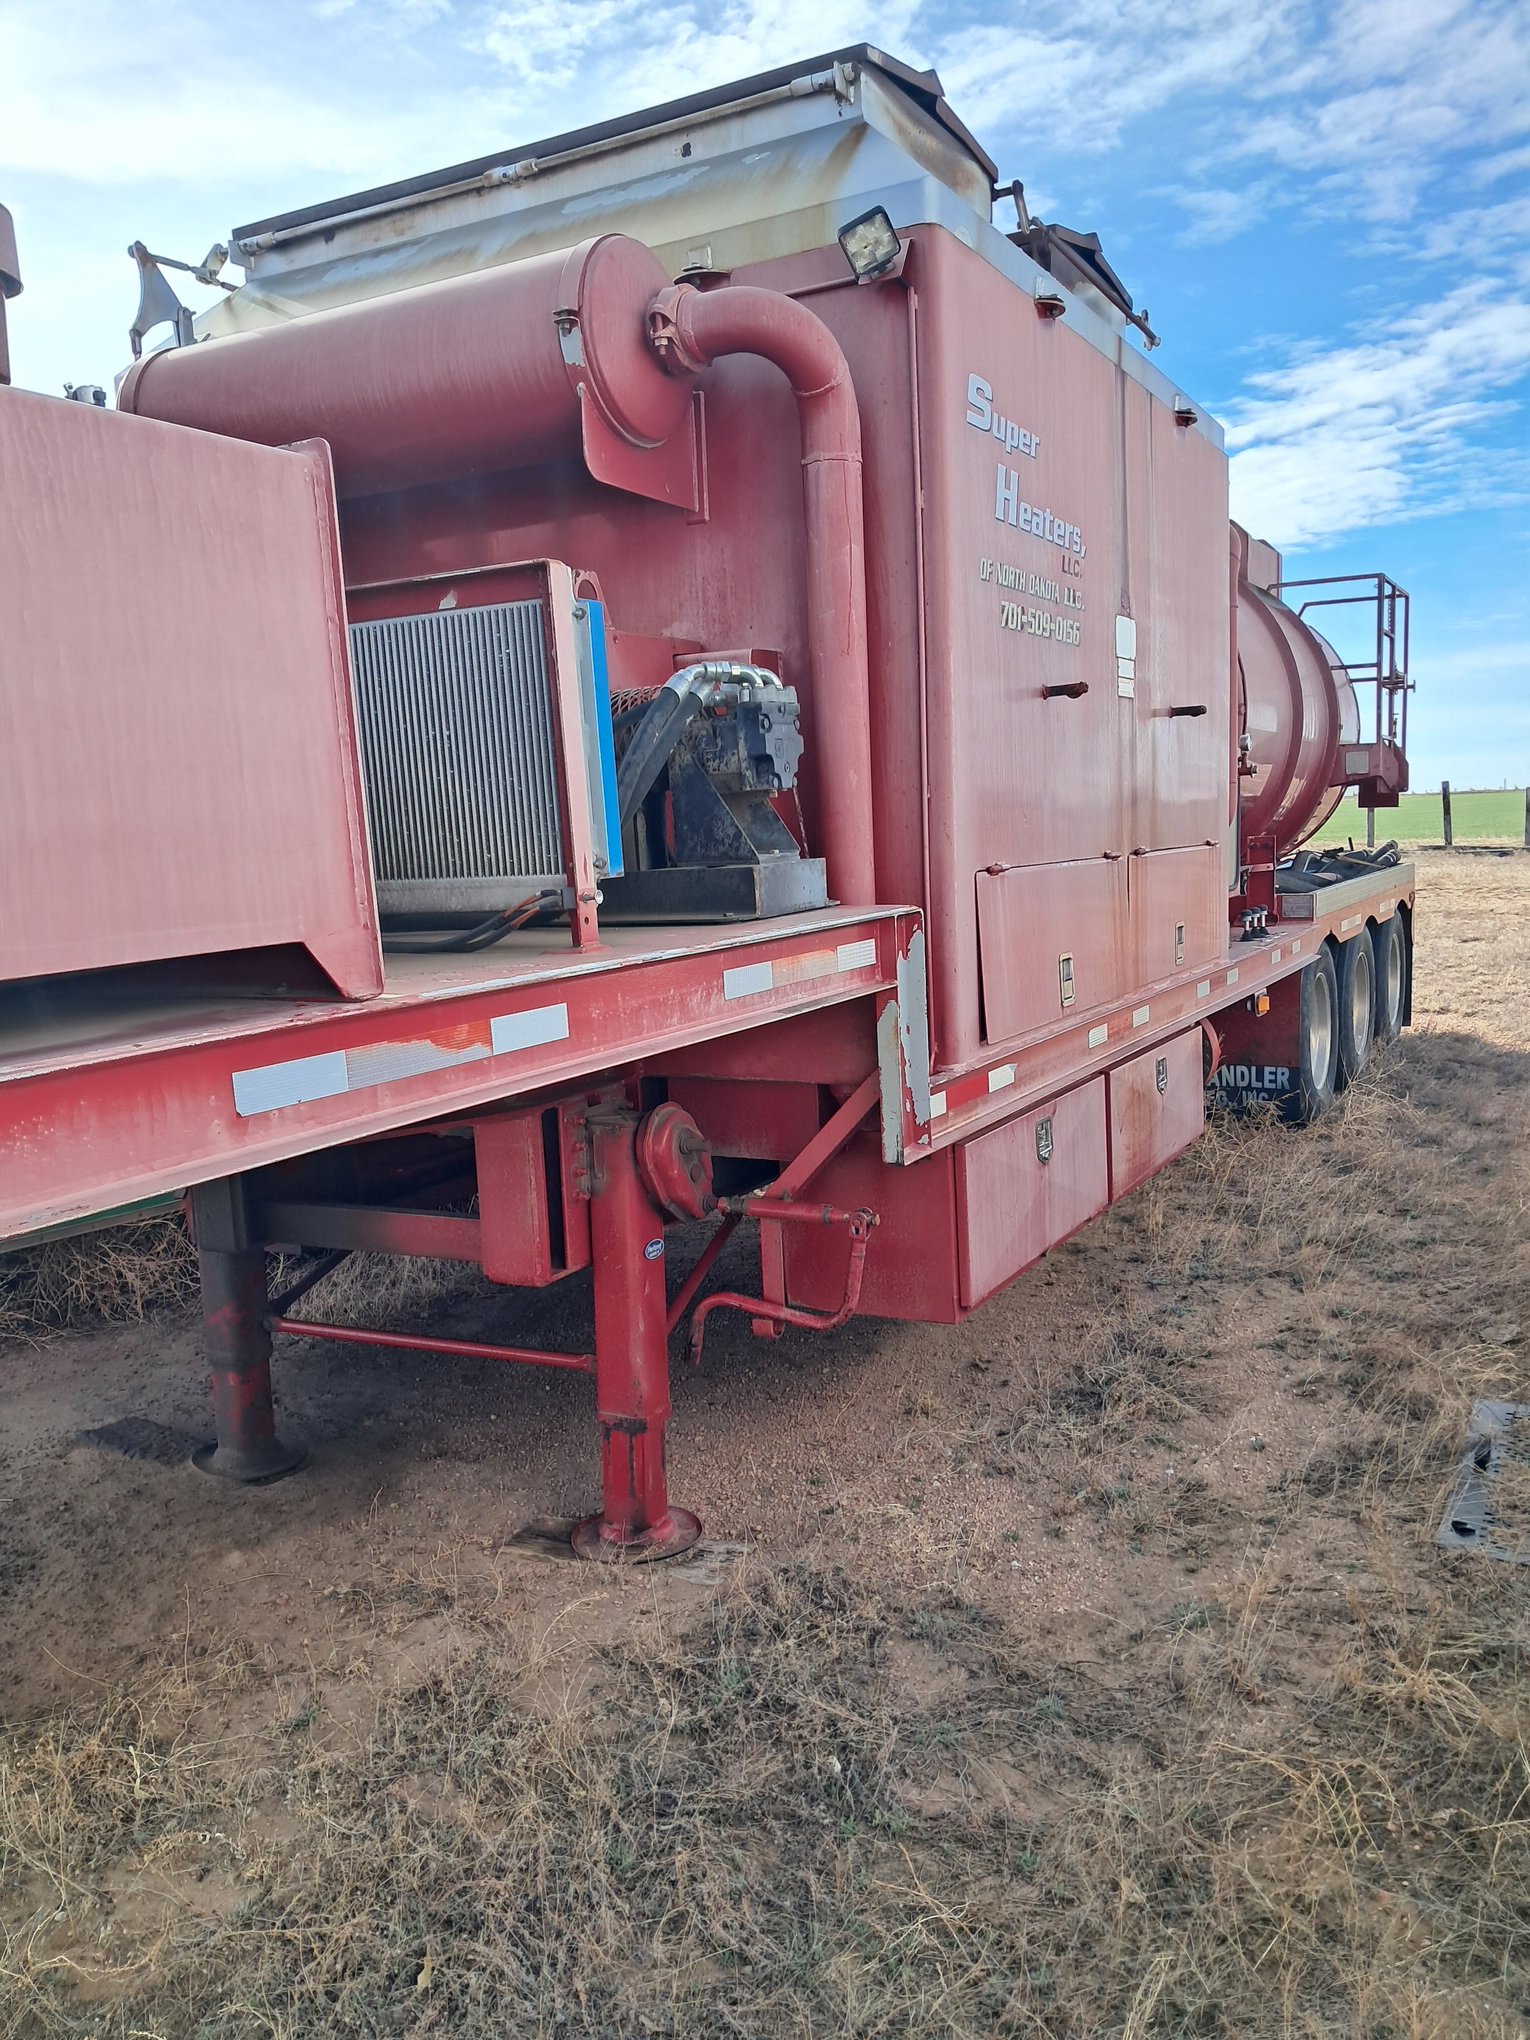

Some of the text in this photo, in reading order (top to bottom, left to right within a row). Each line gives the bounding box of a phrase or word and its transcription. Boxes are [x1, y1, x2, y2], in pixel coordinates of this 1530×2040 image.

[966, 372, 1040, 458] Super
[995, 463, 1087, 558] Heaters,
[980, 557, 993, 581] OF
[995, 562, 1026, 591] NORTH
[1063, 586, 1085, 611] LLC.
[1061, 555, 1082, 578] LLC.
[1001, 600, 1080, 646] 701-509-0156
